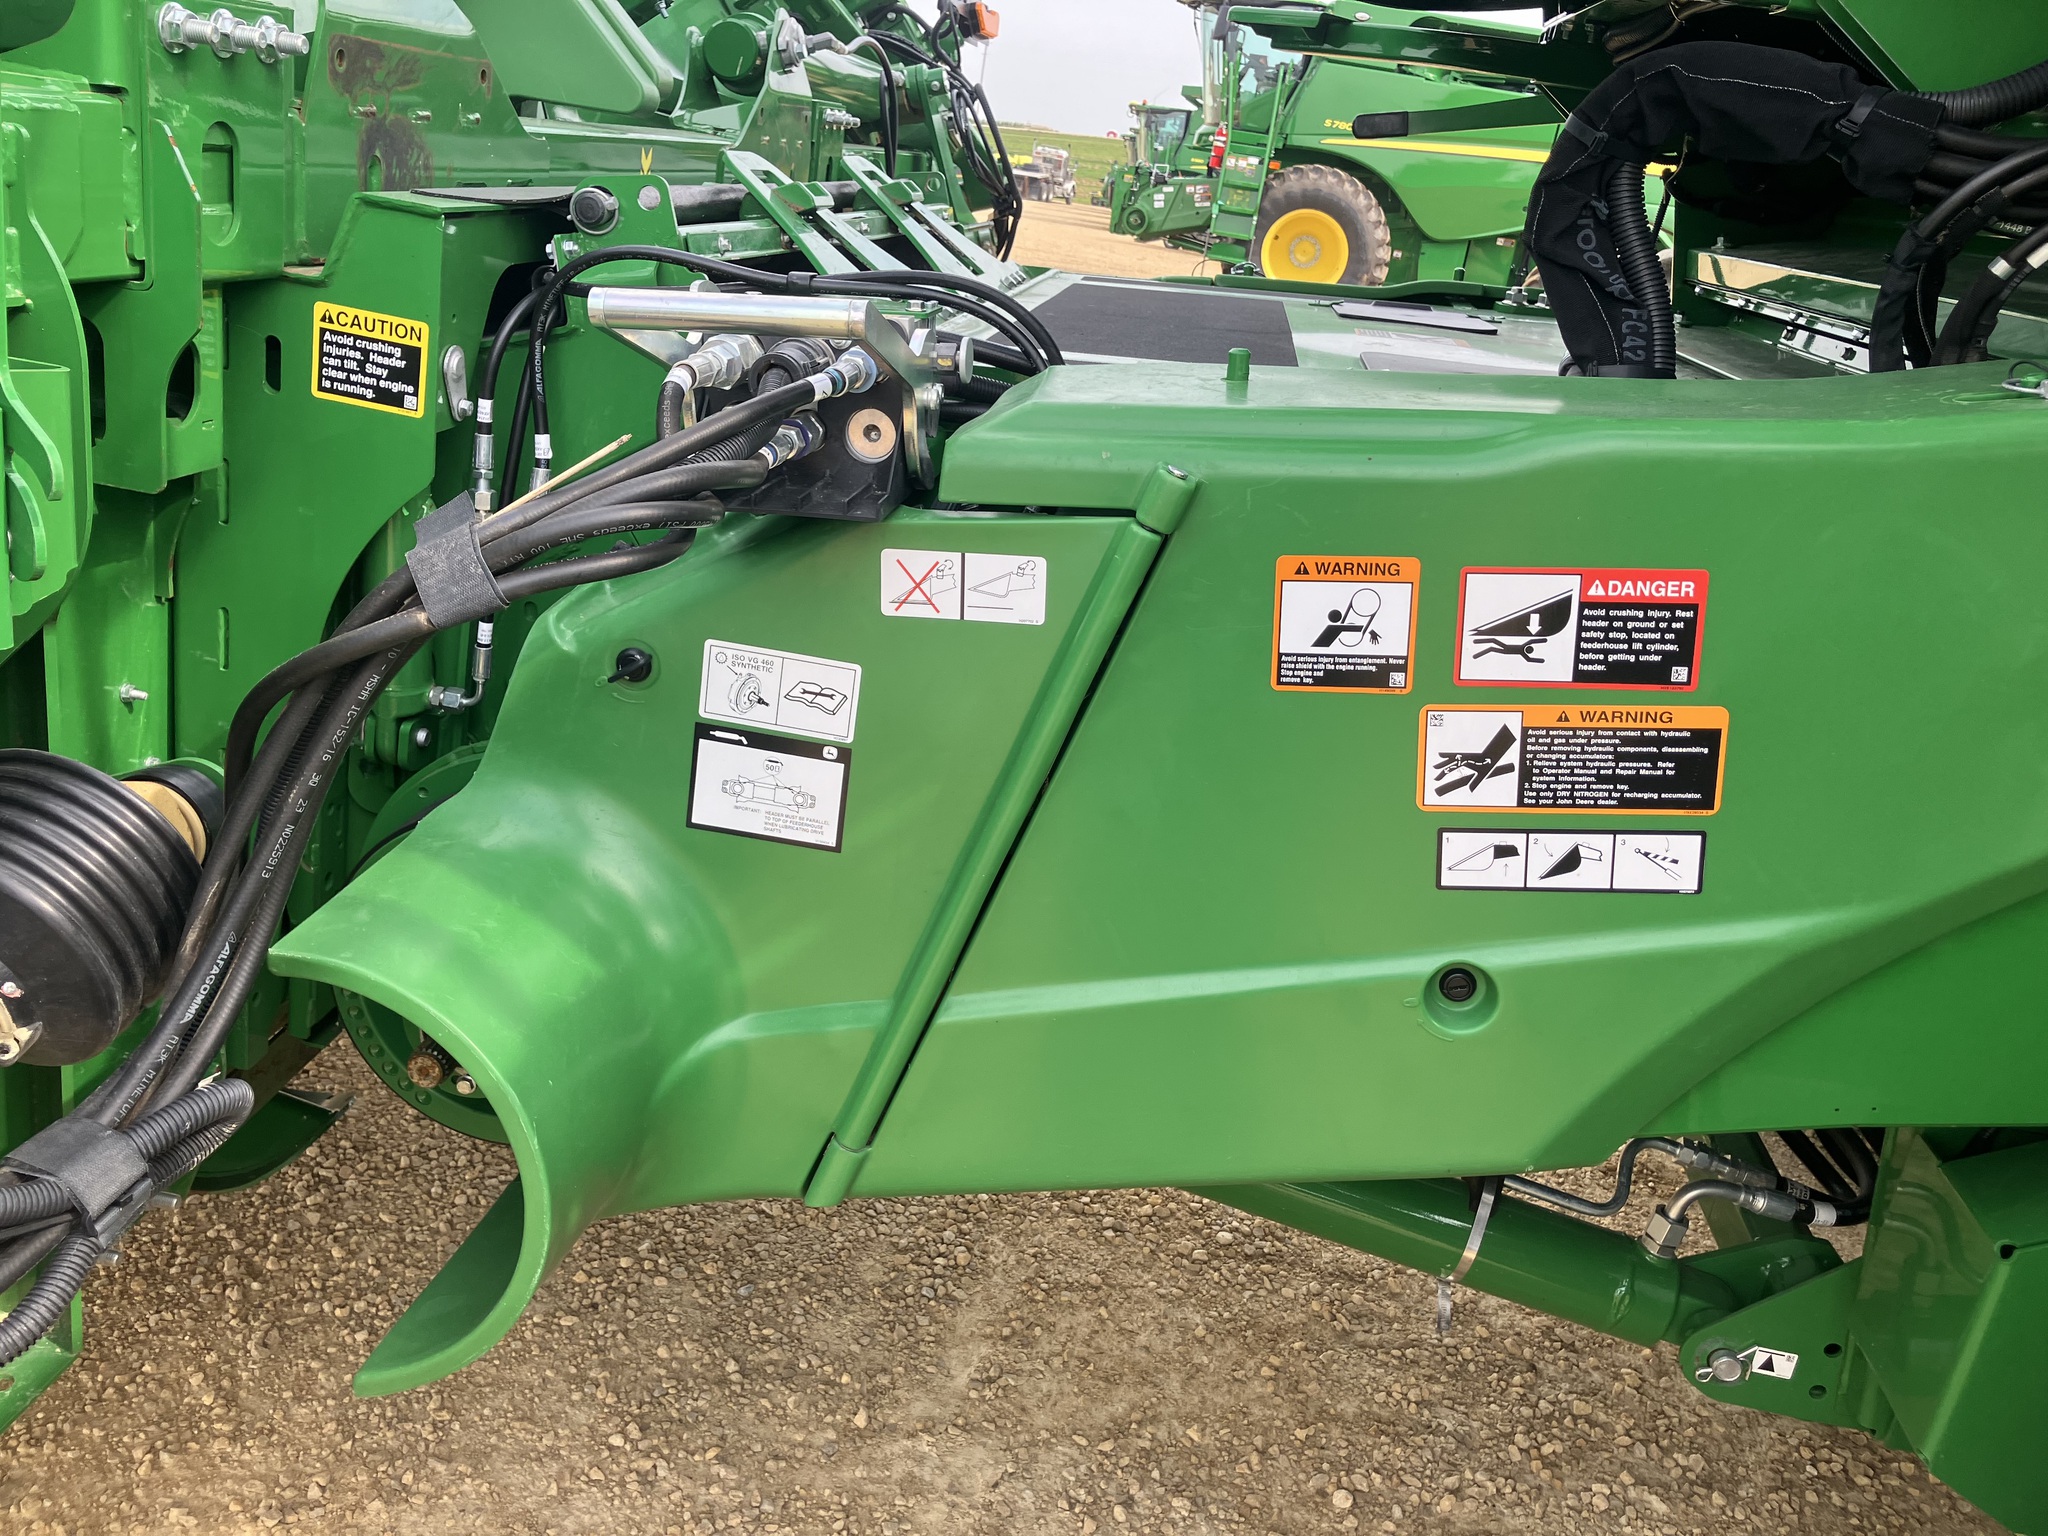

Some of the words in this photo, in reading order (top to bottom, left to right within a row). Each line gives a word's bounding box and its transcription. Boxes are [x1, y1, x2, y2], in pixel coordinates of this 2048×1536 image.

[336, 312, 421, 342] CAUTION
[1621, 307, 1648, 362] FC42
[324, 331, 353, 346] Avoid
[356, 340, 401, 357] crushing
[323, 343, 364, 360] injuries.
[370, 352, 406, 368] Header
[323, 357, 341, 366] can
[344, 360, 360, 370] tilt.
[365, 364, 388, 378] Stay
[534, 338, 542, 396] ALFAGOMMA
[322, 368, 347, 379] clear
[350, 373, 376, 385] when
[379, 380, 414, 393] engine
[322, 378, 331, 387] is
[333, 382, 375, 398] running.
[1315, 562, 1400, 576] WARNING
[1608, 580, 1695, 597] DANGER
[1583, 608, 1605, 616] Avoid
[1609, 609, 1644, 618] crushing
[1648, 610, 1671, 618] injury.
[1627, 620, 1655, 628] ground
[1581, 631, 1605, 640] safety
[1646, 643, 1679, 652] cylinder,
[732, 654, 744, 662] ISO
[748, 656, 759, 664] VG
[761, 658, 774, 666] 460
[1608, 654, 1635, 662] getting
[732, 661, 773, 673] SYNTHETIC
[1580, 711, 1673, 723] WARNING
[322, 705, 360, 762] IC-152/16
[296, 798, 308, 812] 23
[180, 941, 230, 1024] ALFAGOMMA
